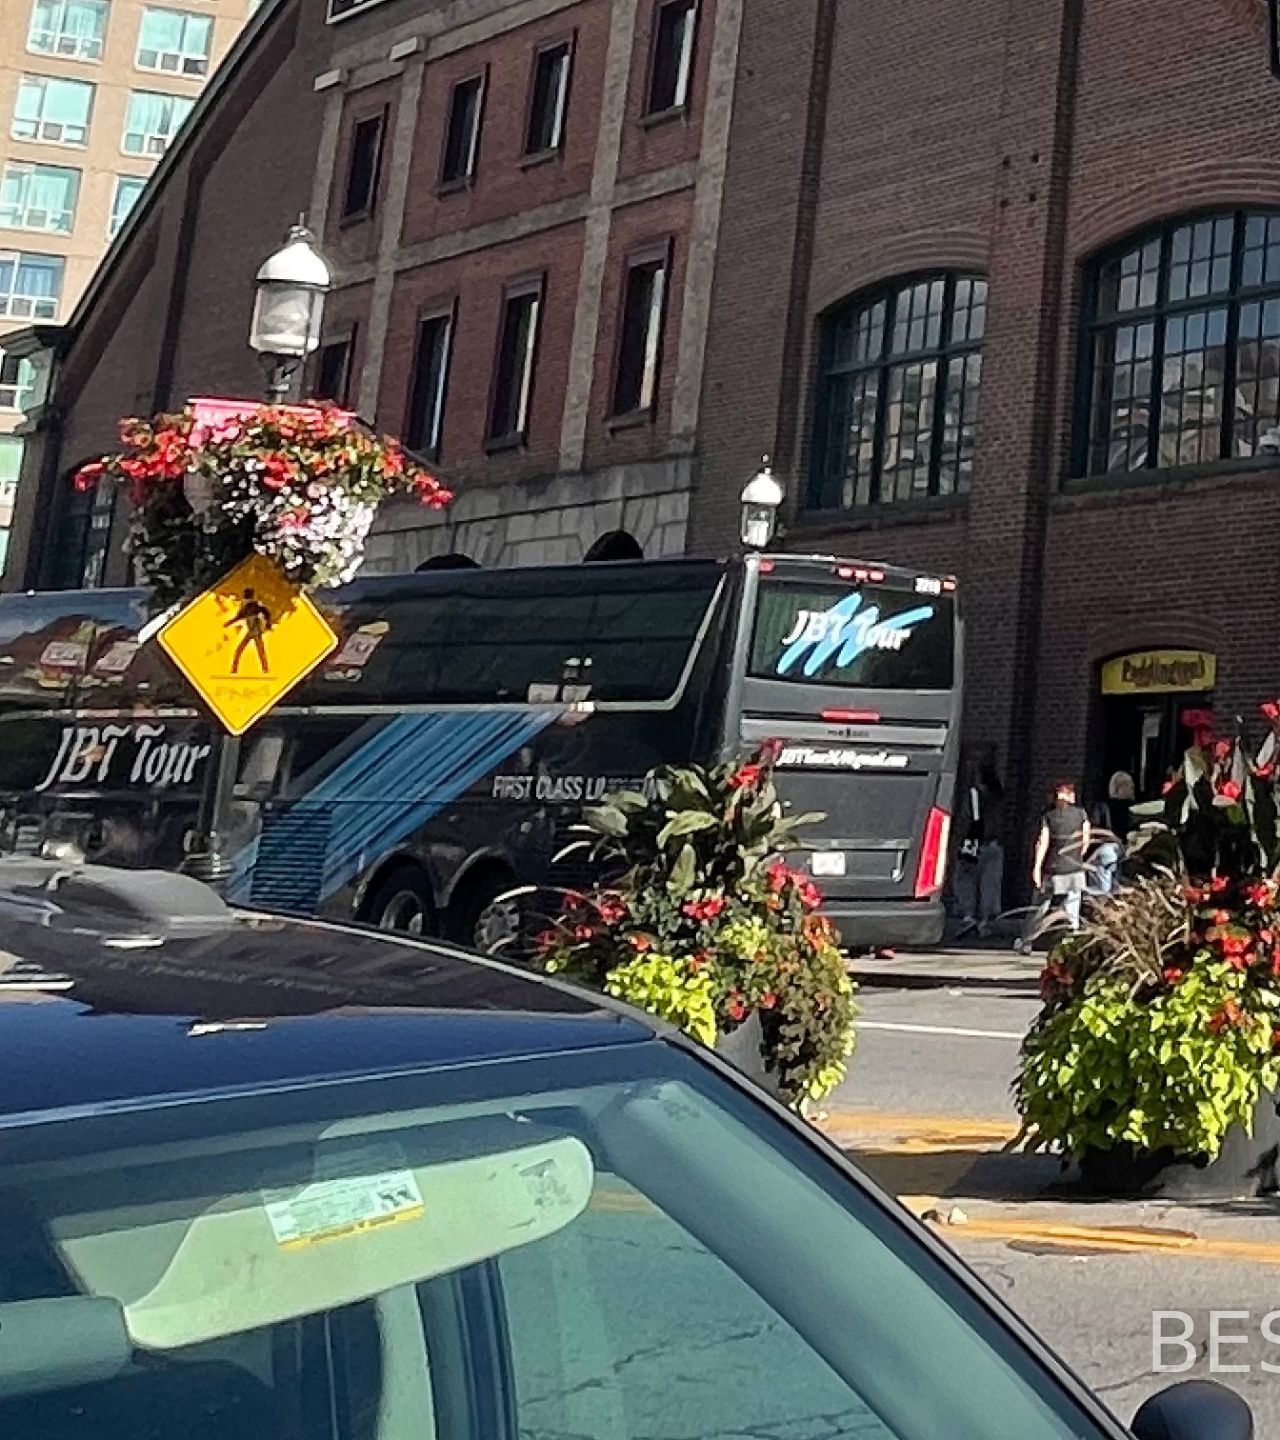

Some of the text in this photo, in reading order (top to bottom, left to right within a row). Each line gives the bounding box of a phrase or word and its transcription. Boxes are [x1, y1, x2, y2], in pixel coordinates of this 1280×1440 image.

[33, 724, 212, 792] JBT Tour
[492, 775, 534, 800] FIRST
[535, 775, 584, 801] CLASS
